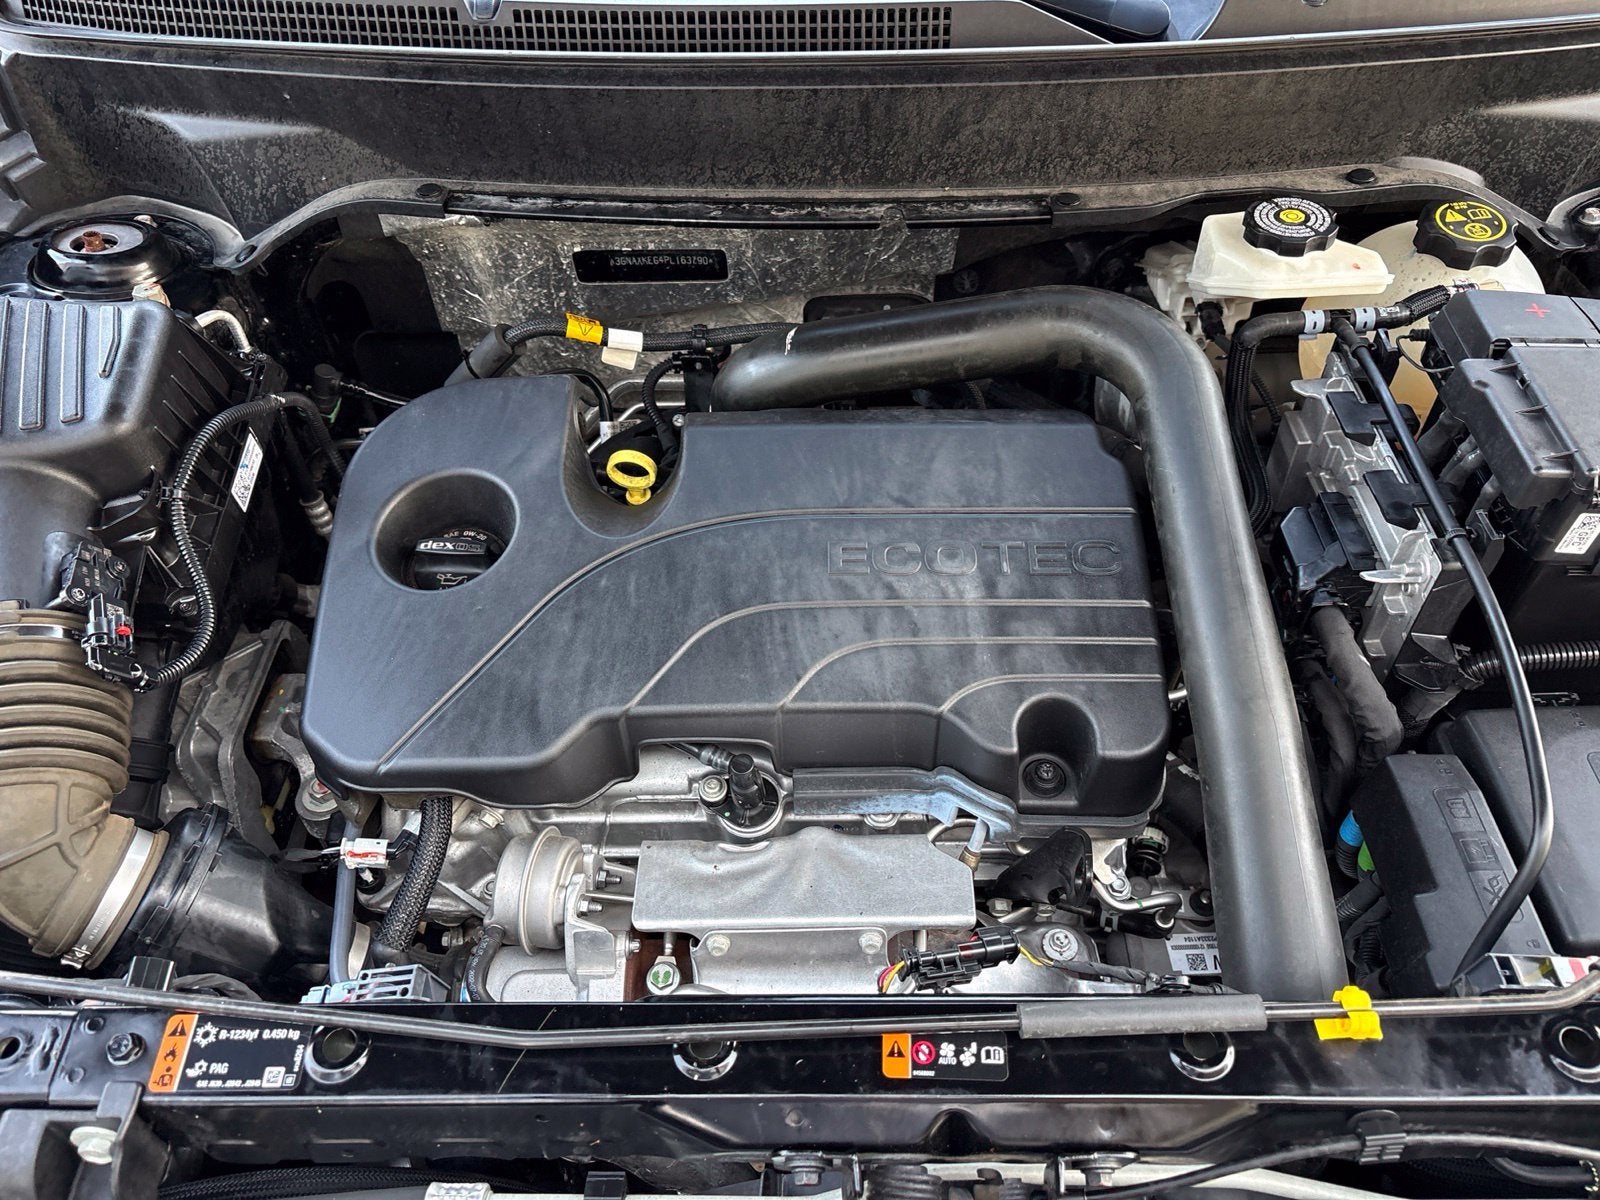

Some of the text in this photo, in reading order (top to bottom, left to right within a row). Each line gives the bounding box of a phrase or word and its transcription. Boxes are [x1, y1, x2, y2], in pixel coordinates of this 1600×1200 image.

[463, 530, 487, 541] 0W-20
[419, 540, 481, 552] dexos
[827, 539, 1122, 577] ECOTEC
[218, 1028, 301, 1042] R-1234yf 0.450 kg
[938, 1057, 957, 1065] AUTO
[208, 1062, 229, 1075] PAG
